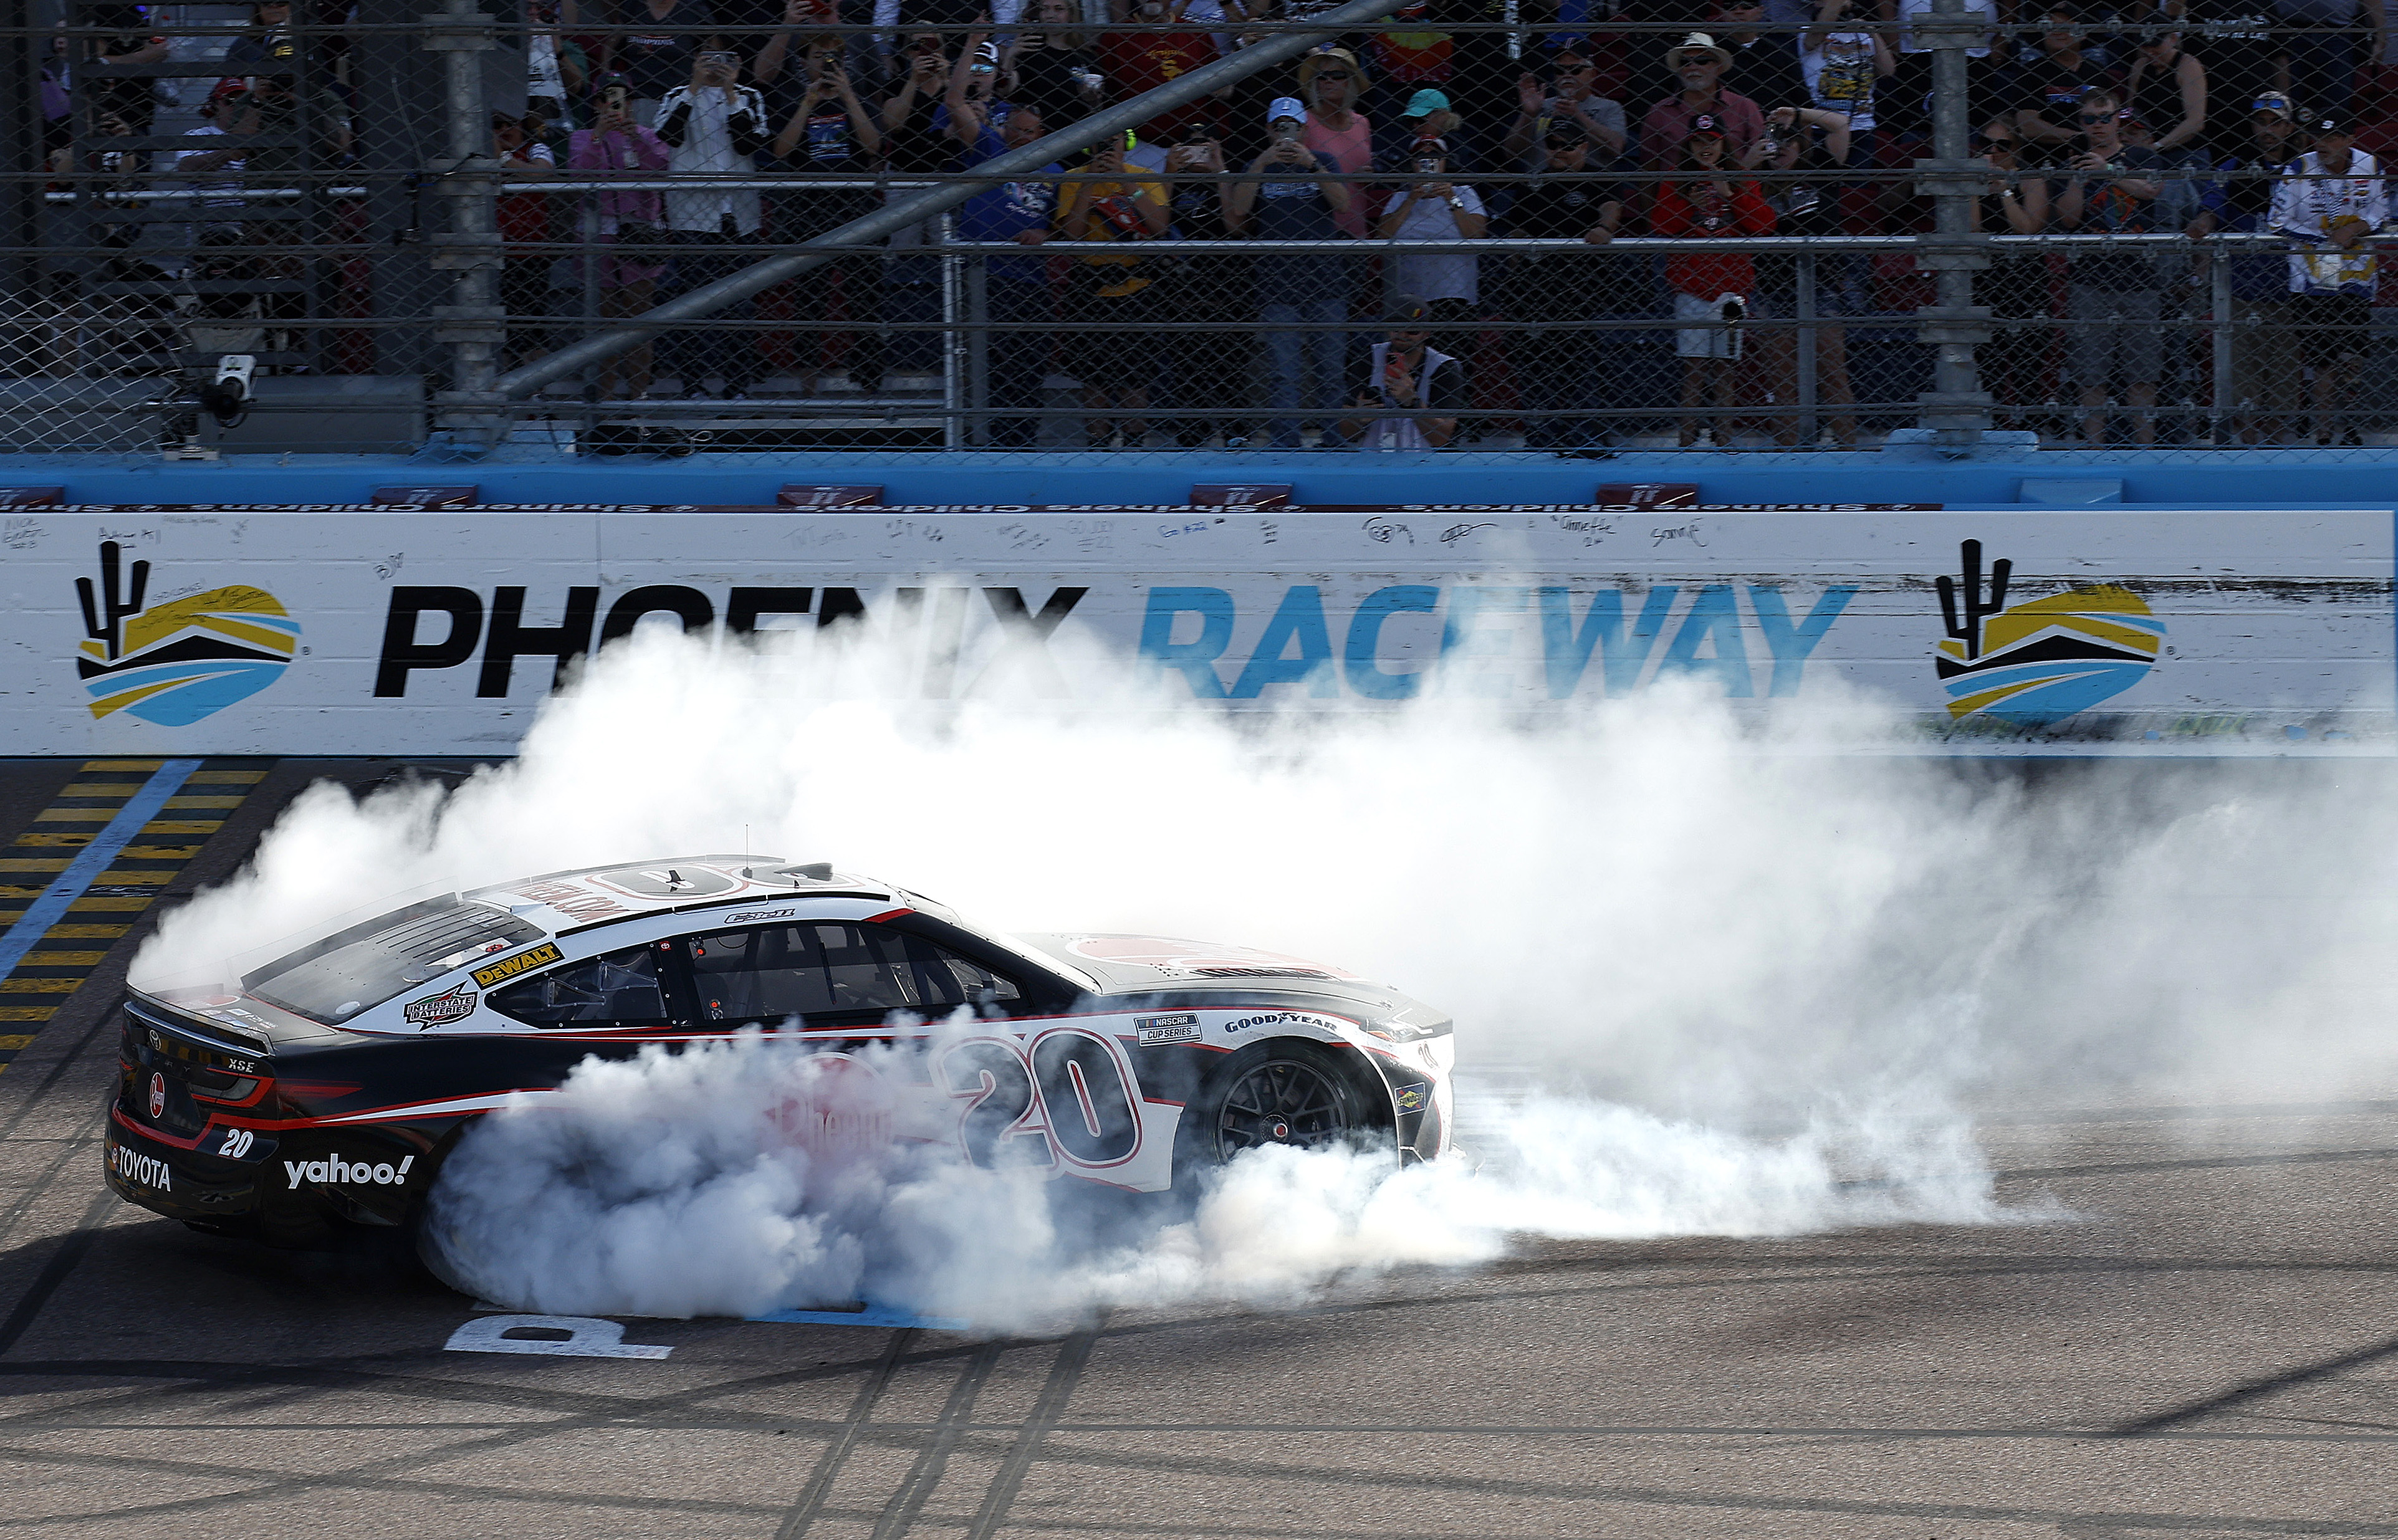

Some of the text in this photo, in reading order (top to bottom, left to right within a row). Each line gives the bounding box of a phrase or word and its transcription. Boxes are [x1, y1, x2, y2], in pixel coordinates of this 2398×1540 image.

[439, 504, 653, 512] Shriners
[1045, 504, 1260, 512] Shriners
[1652, 504, 1868, 512] Shriners
[1134, 585, 1859, 699] RACEWAY
[410, 996, 472, 1012] INTERSTATE
[413, 1005, 470, 1019] BATTERIES
[1156, 1016, 1189, 1026] NASCAR
[1225, 1012, 1338, 1033] GOODYEAR
[1148, 1027, 1192, 1039] CUP SERIES
[228, 1059, 255, 1074] XSE
[934, 1027, 1142, 1173] 20
[218, 1127, 254, 1159] 20
[118, 1145, 171, 1192] TOYOTA
[284, 1154, 415, 1190] yahoo!
